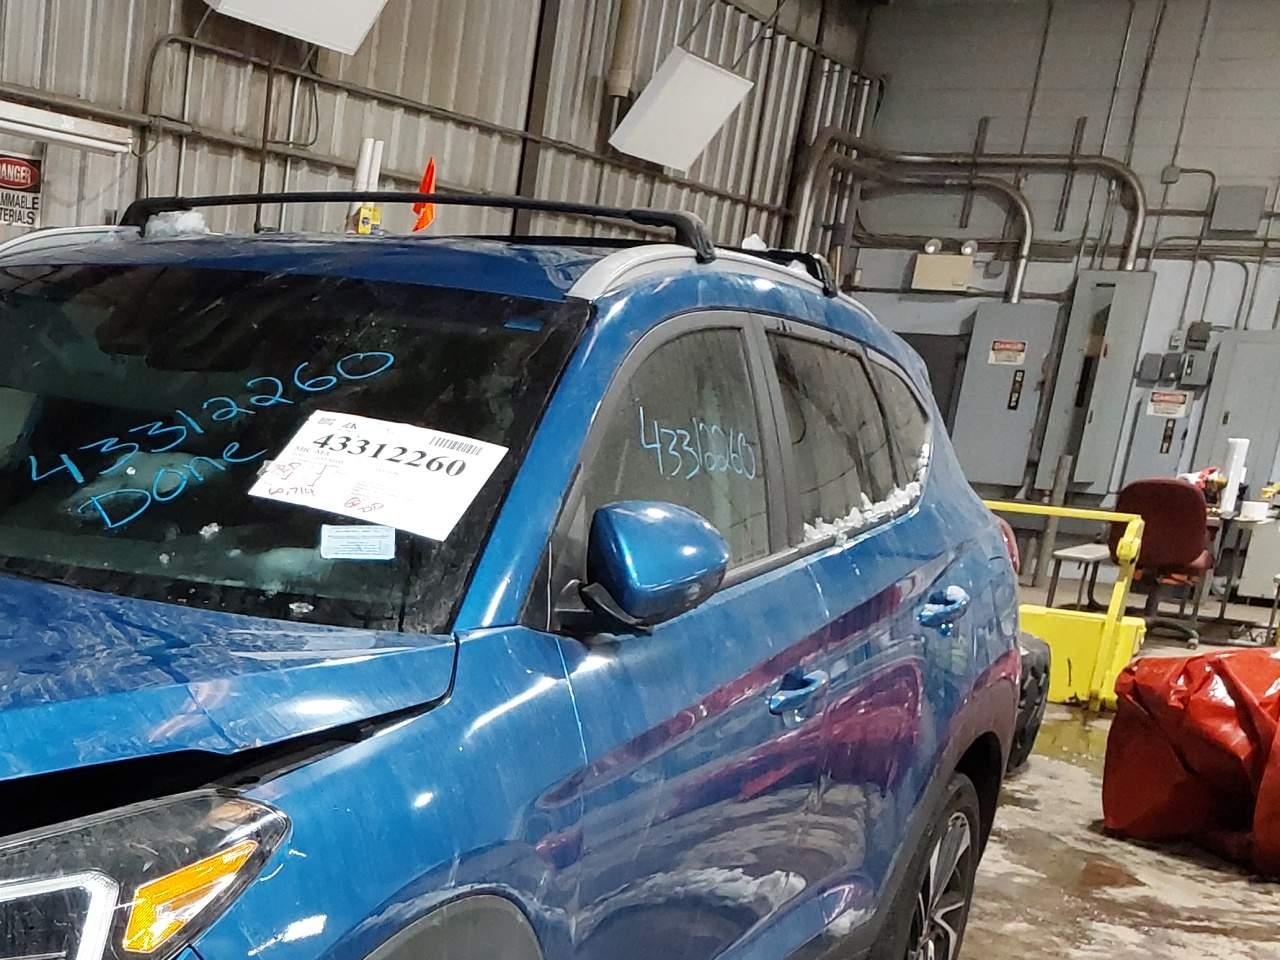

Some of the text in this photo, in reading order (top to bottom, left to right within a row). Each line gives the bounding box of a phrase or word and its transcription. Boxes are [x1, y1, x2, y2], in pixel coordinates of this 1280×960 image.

[29, 351, 394, 483] 43312260
[313, 433, 467, 477] 43312260
[639, 406, 756, 480] 43312260
[77, 441, 268, 529] Done
